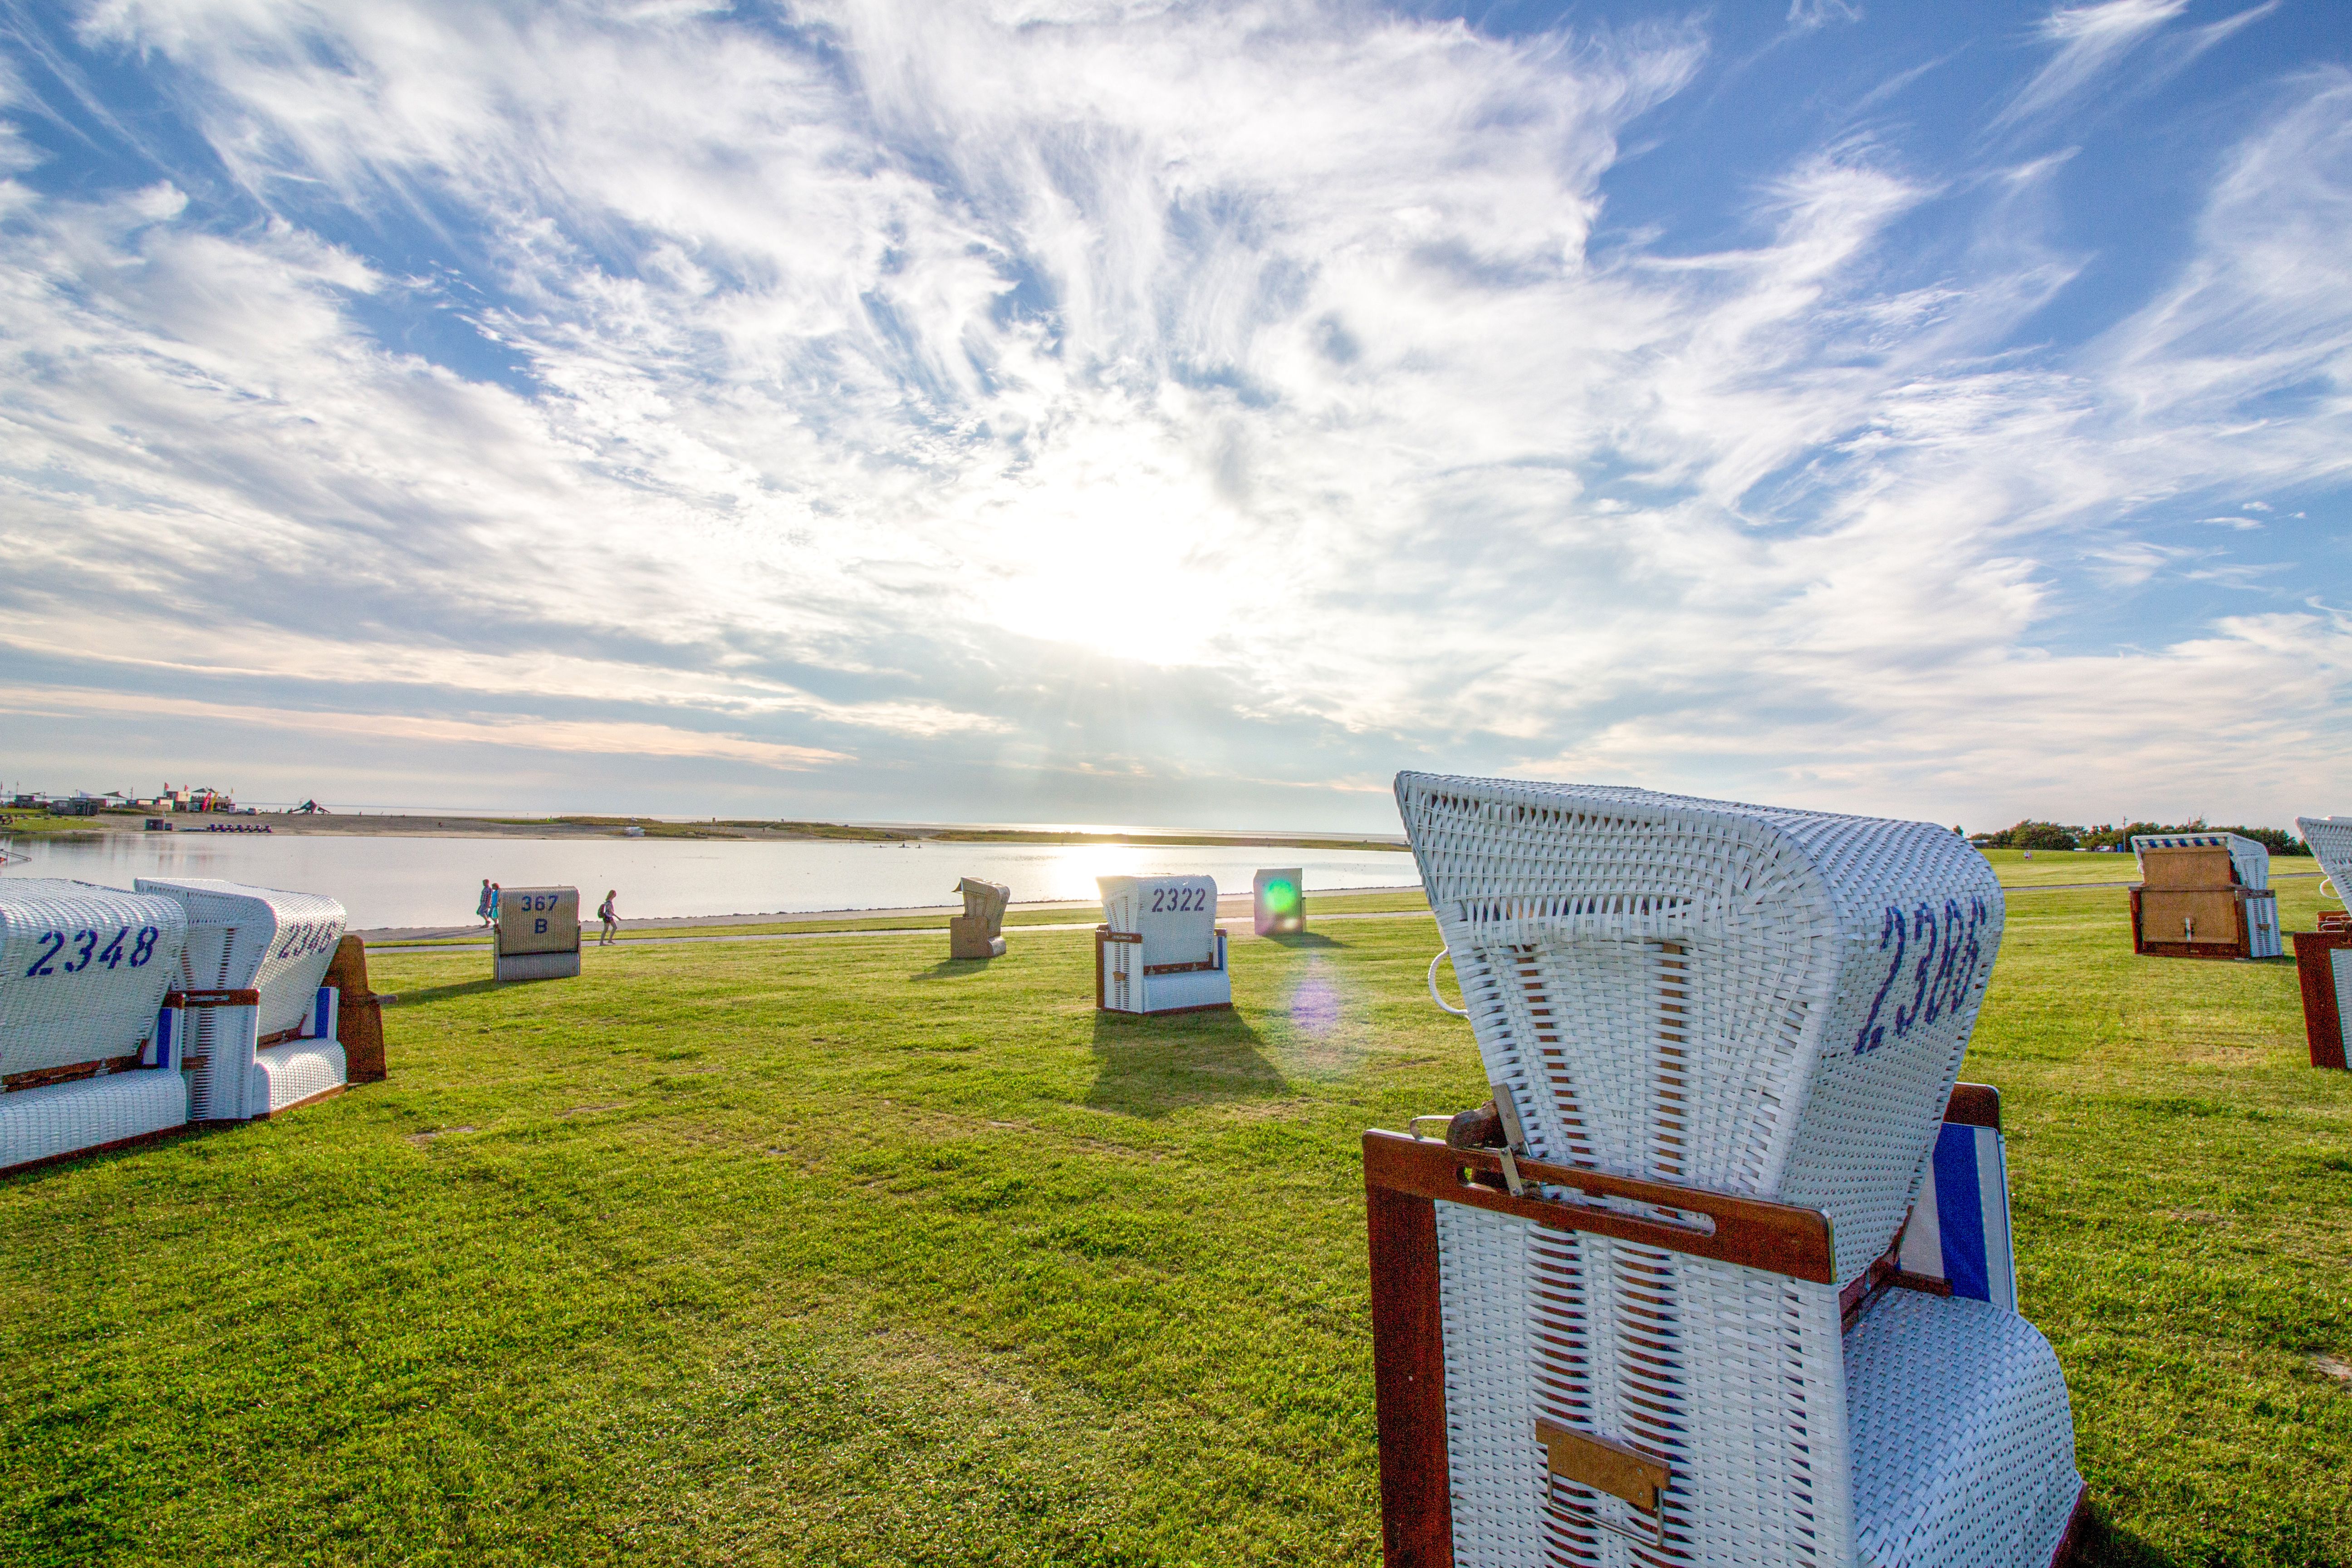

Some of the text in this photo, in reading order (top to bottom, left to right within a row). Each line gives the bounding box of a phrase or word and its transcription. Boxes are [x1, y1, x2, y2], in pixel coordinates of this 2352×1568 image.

[521, 895, 558, 911] 367
[1152, 887, 1206, 913] 2322
[278, 921, 337, 959] 2346
[534, 918, 548, 934] B
[26, 926, 159, 977] 2348
[1854, 896, 1986, 1056] 2386
